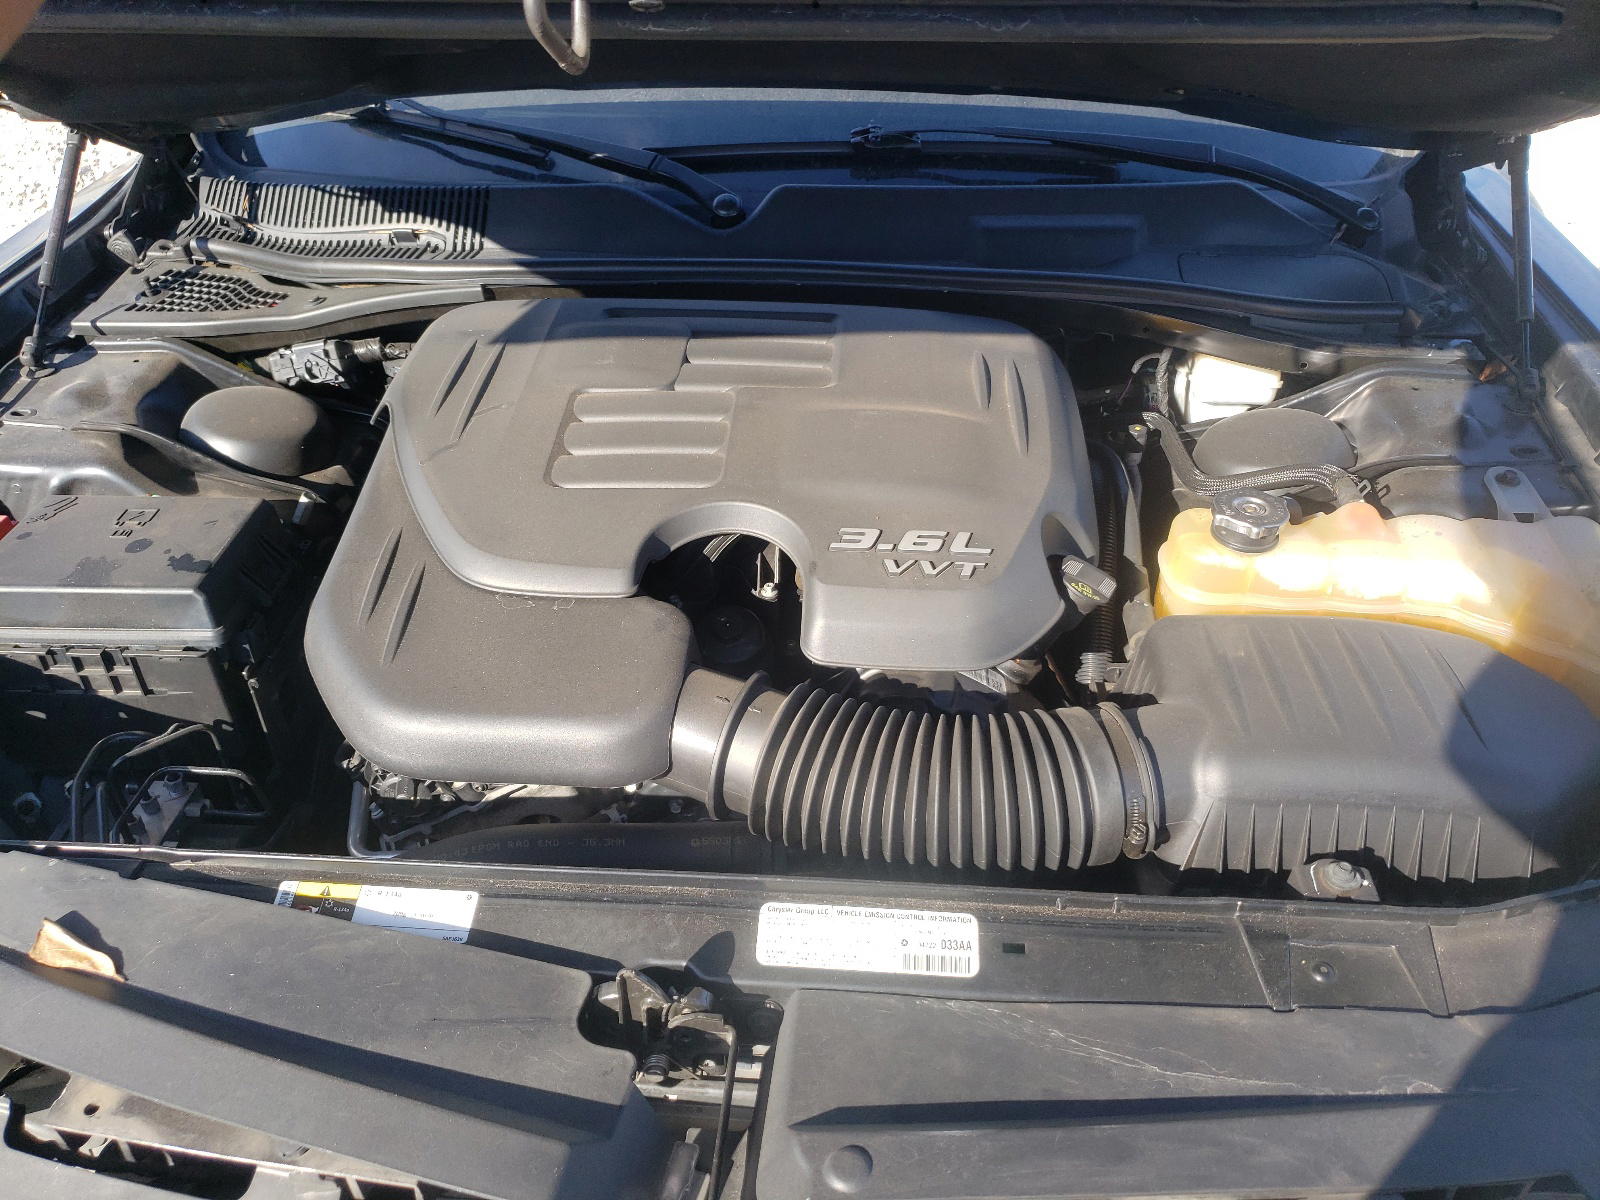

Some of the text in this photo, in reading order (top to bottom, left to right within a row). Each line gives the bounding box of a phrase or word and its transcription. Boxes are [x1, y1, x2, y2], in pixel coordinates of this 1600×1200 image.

[828, 527, 995, 557] 3.6L
[881, 558, 989, 580] VVT
[836, 909, 972, 923] VEHICLE EMISSION CONTROL INFORMATION
